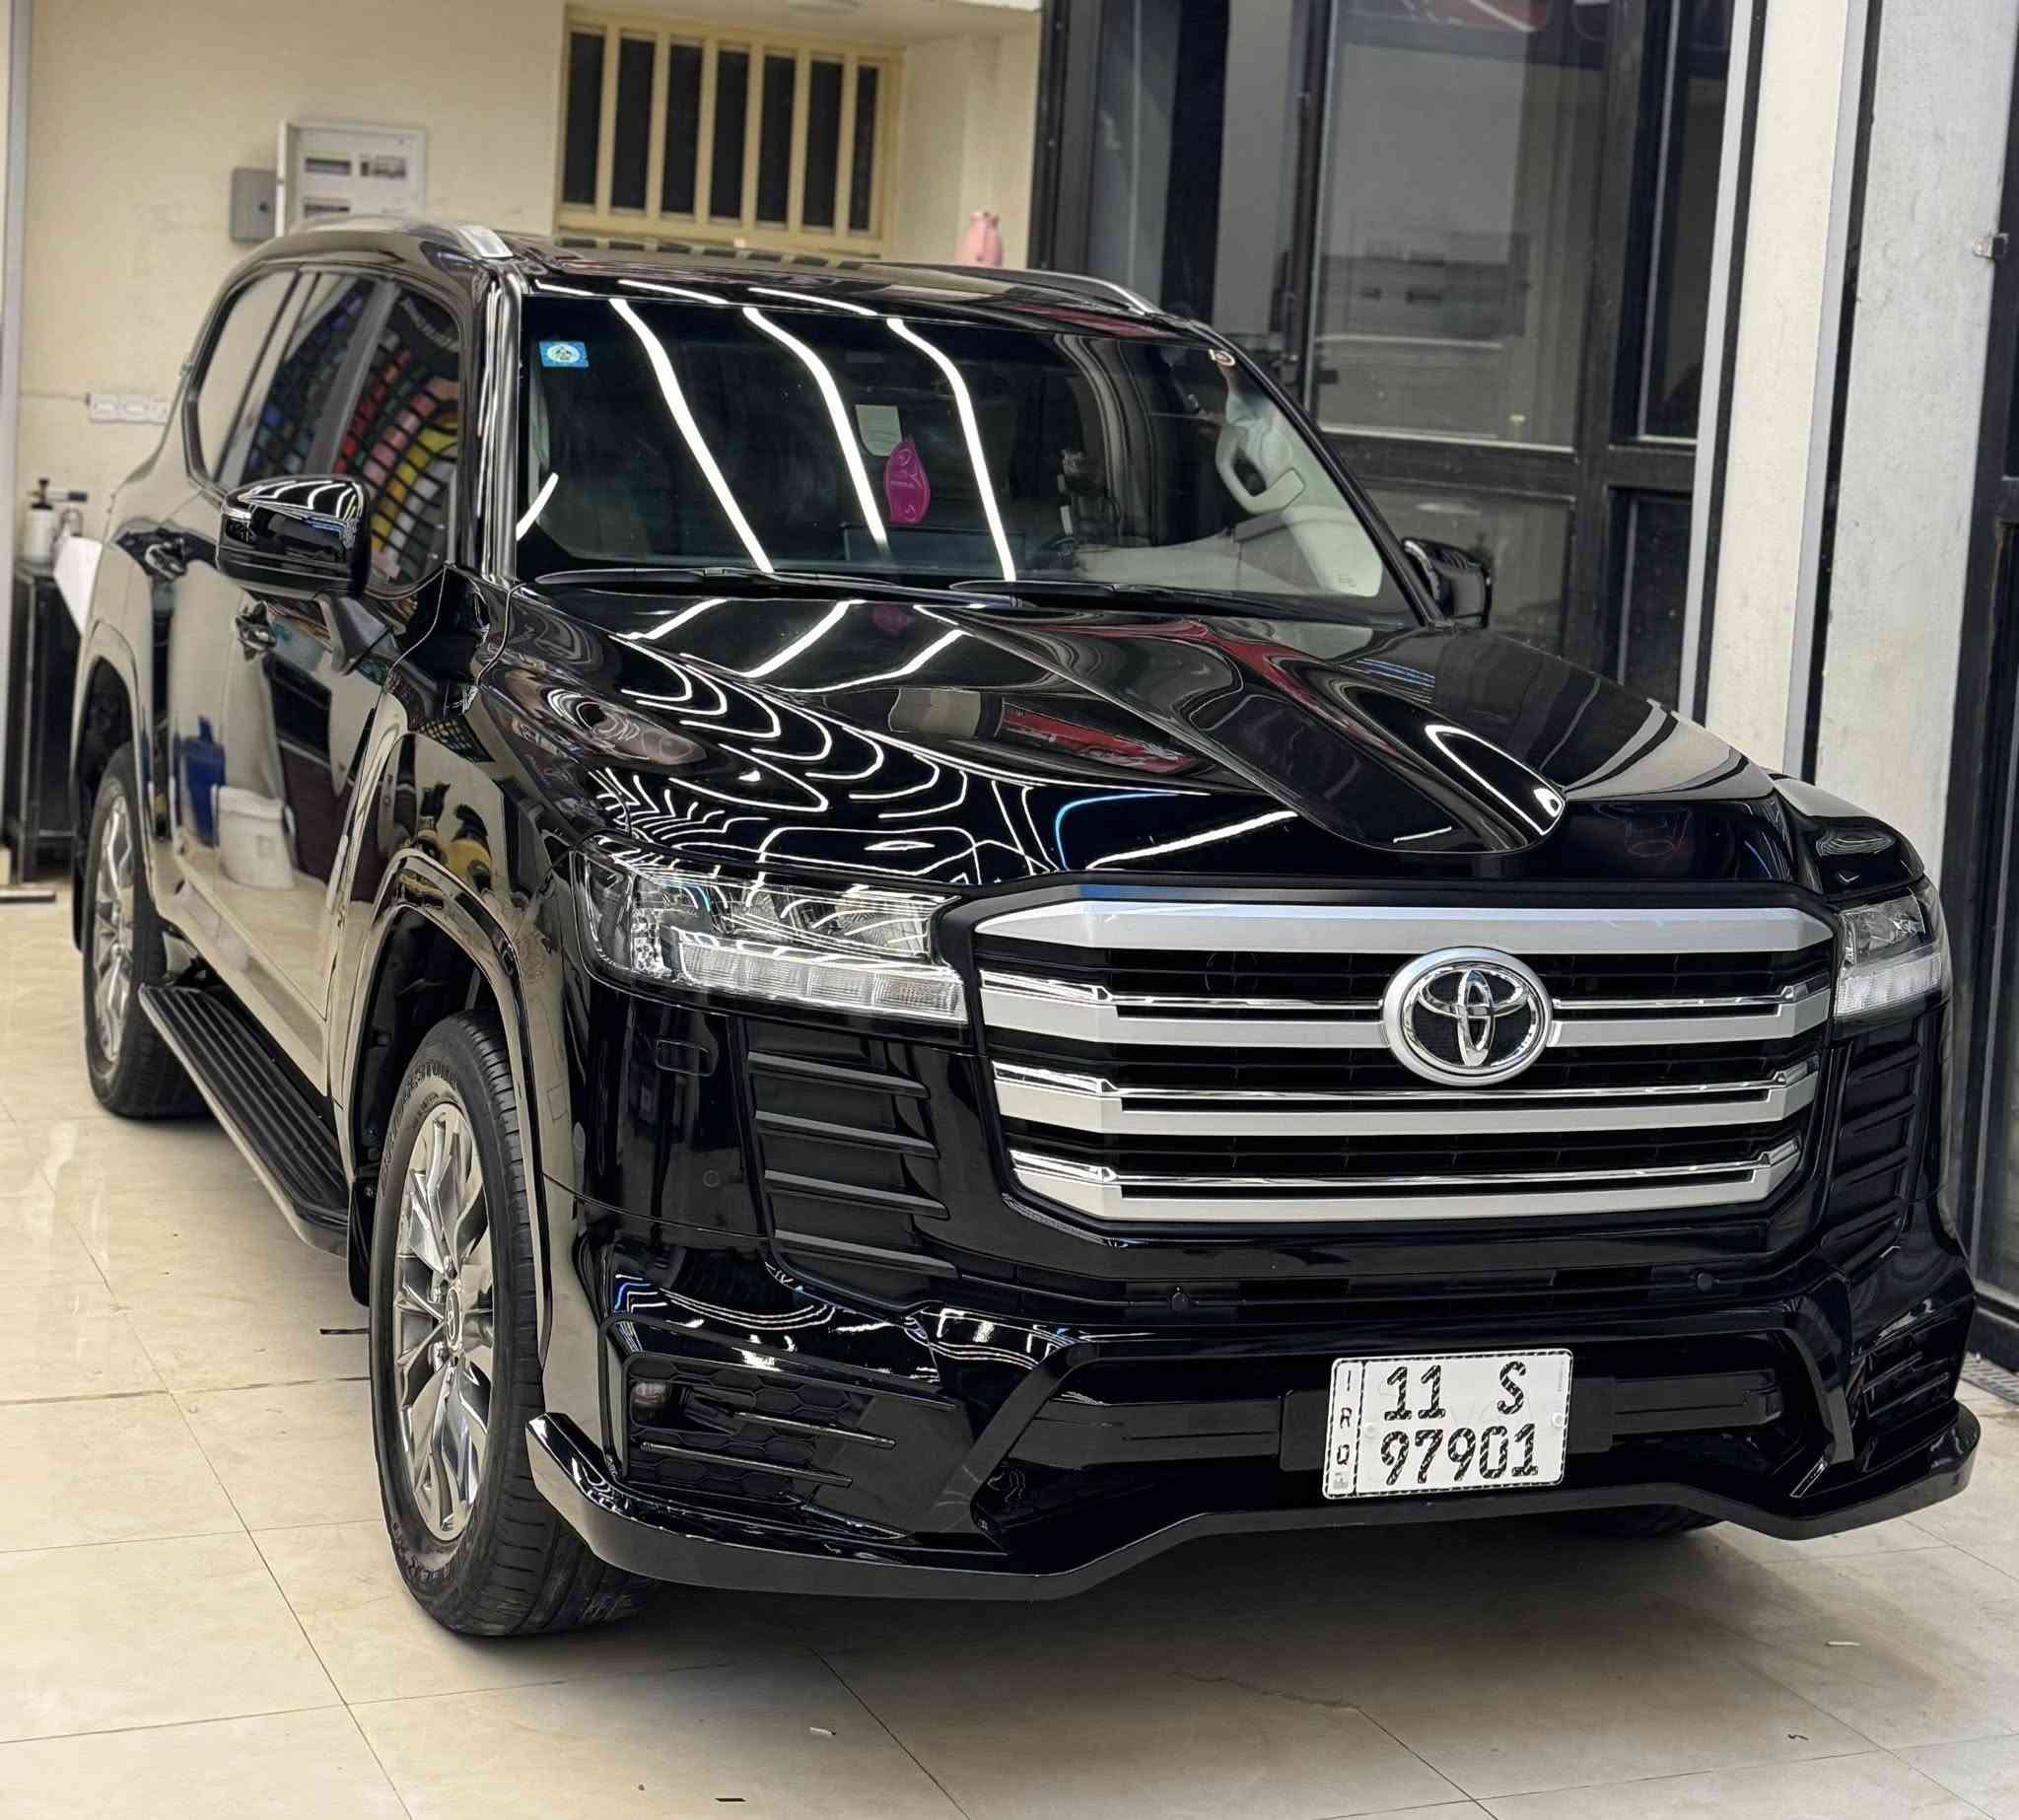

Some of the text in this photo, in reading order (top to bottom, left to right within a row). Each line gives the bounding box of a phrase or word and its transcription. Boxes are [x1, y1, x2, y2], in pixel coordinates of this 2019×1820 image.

[1384, 1365, 1445, 1421] 11
[1497, 1361, 1526, 1415] S
[1381, 1423, 1539, 1485] 97901
